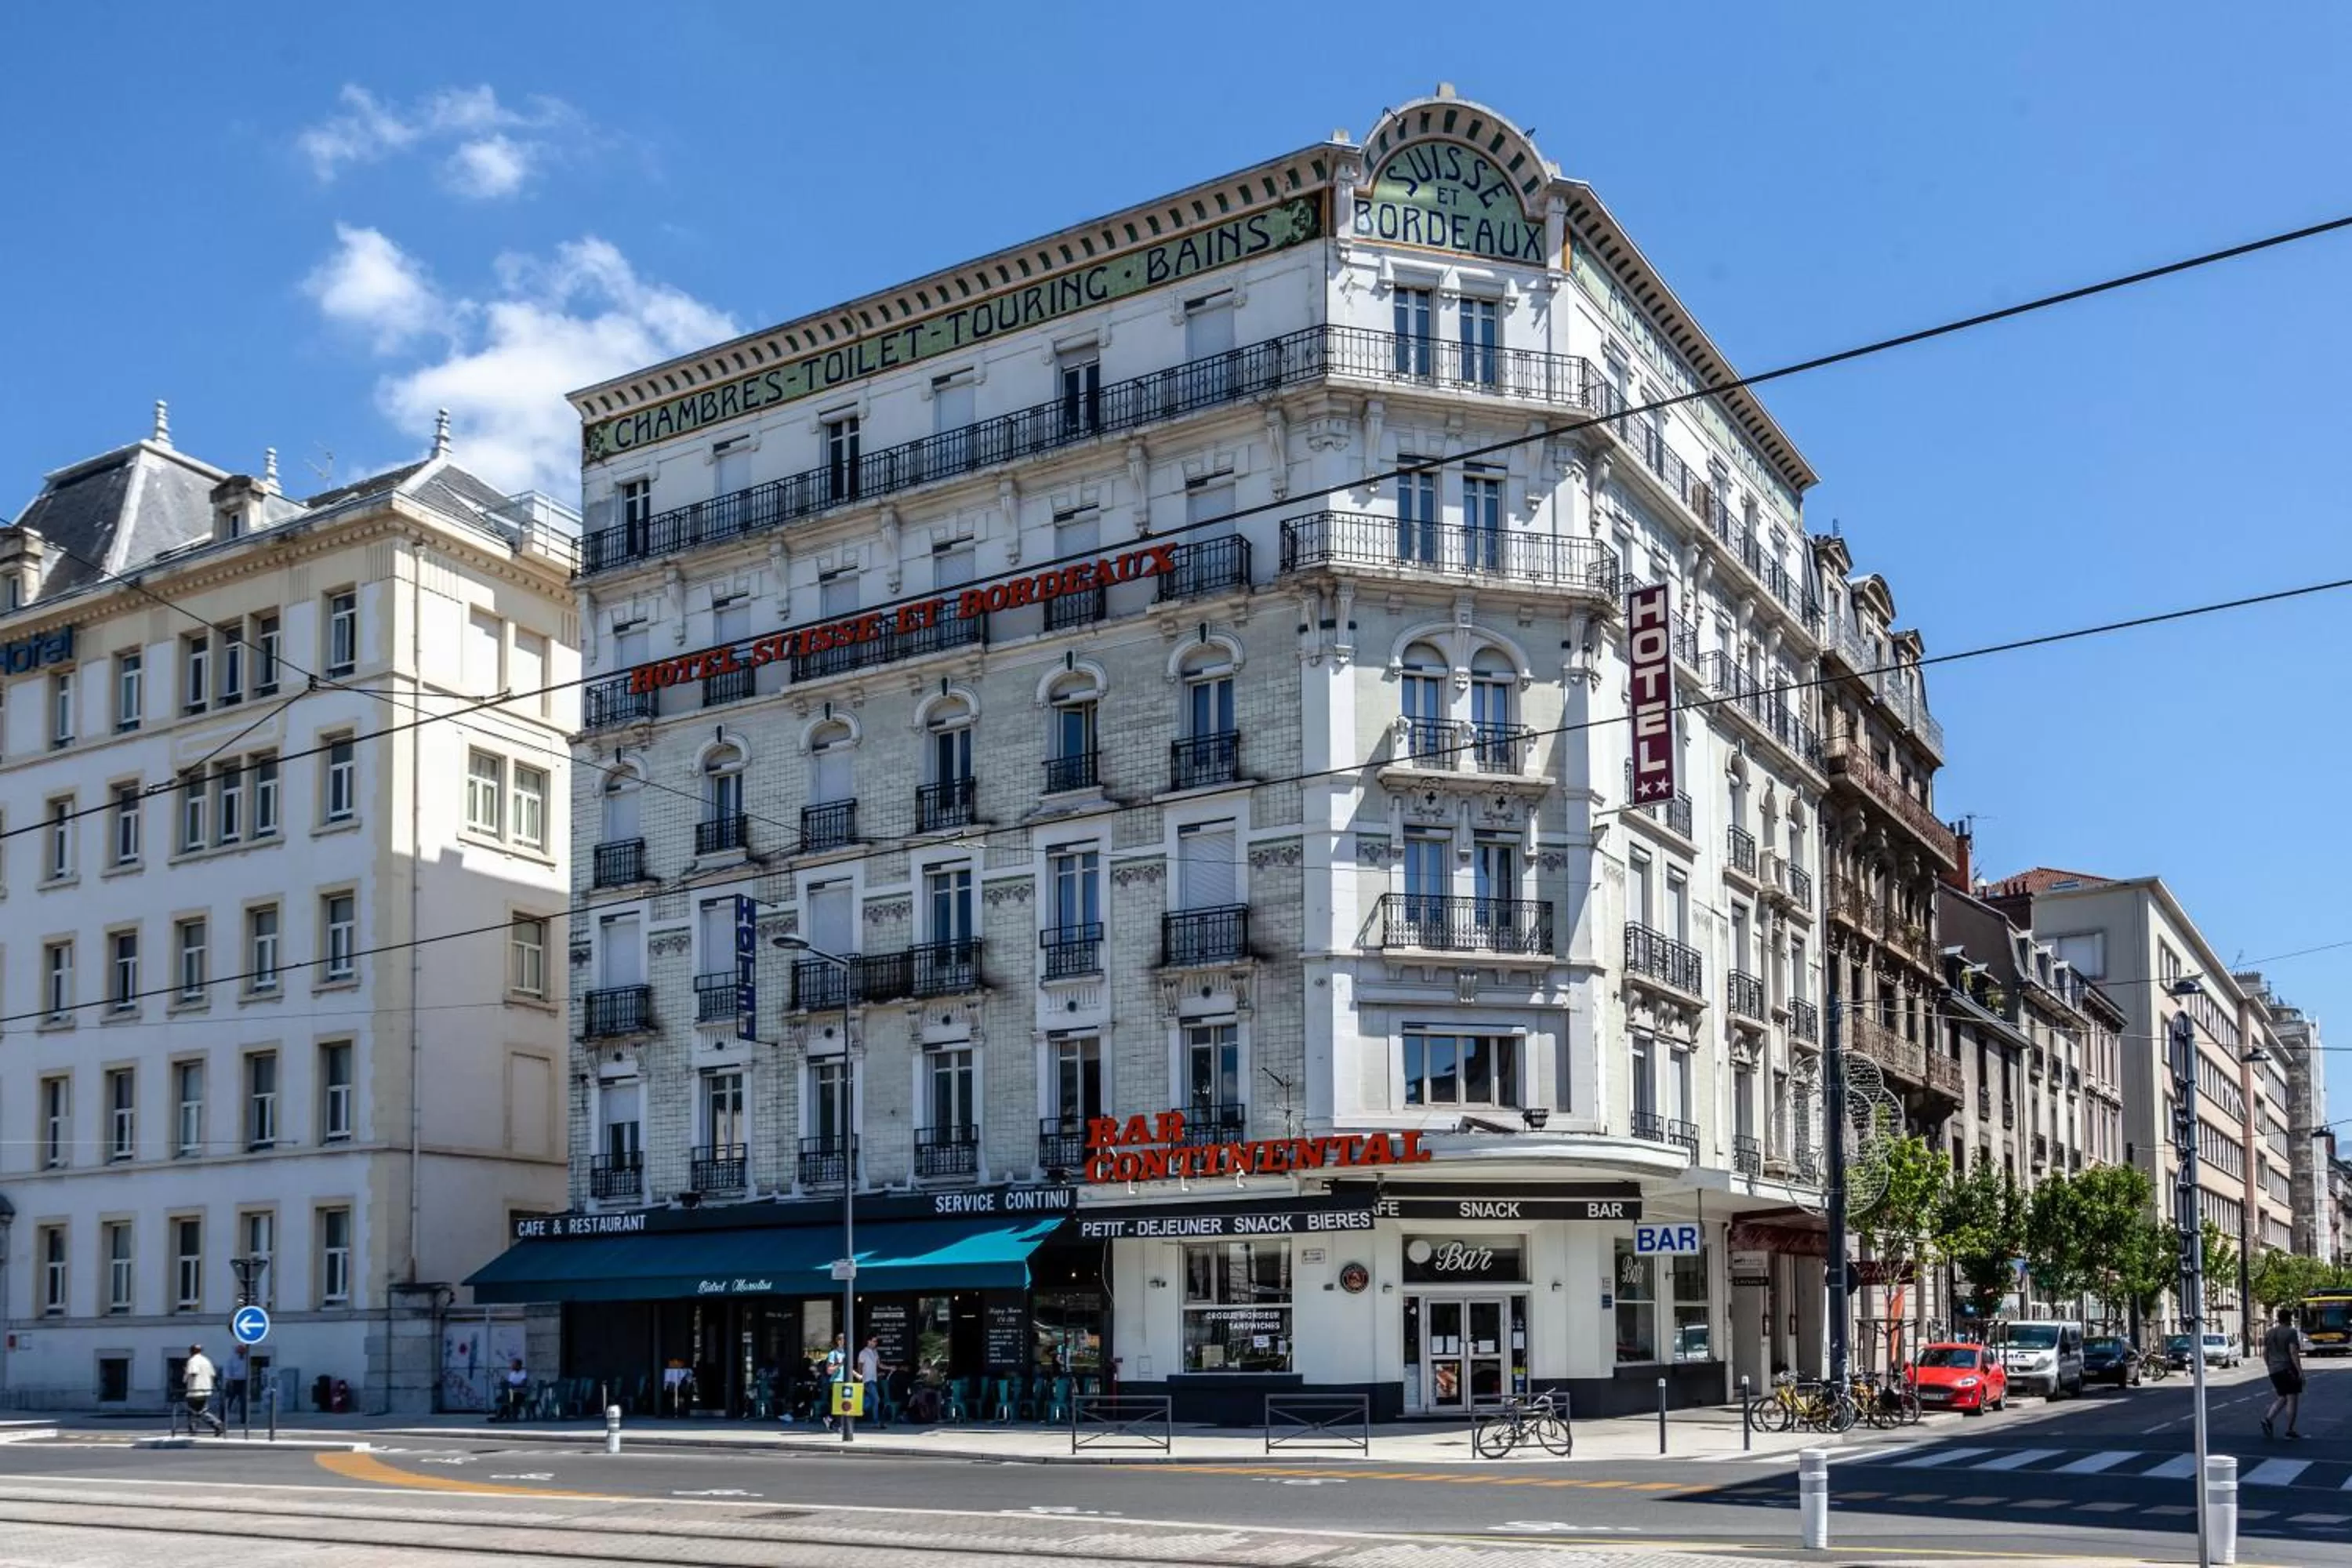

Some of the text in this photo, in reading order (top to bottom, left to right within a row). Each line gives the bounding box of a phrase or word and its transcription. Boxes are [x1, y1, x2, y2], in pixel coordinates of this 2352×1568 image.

[1385, 144, 1511, 209] SUISSE
[1437, 187, 1460, 206] ET
[1354, 199, 1542, 261] BORDEAUX
[615, 372, 782, 448] CHAMBRES
[800, 325, 925, 390] TOILET
[946, 265, 1109, 345] TOURING
[1147, 214, 1271, 284] BAINS
[630, 542, 1178, 695] HOTEL SUISSE ET BORDEAUX
[1632, 590, 1668, 774] HOTEL
[1085, 1111, 1185, 1148] BAR
[1085, 1129, 1432, 1185] CONTINENTAL
[935, 1189, 1069, 1213] SERVICE CONTINU
[1459, 1202, 1521, 1218] SNACK
[1588, 1203, 1624, 1218] BAR
[517, 1214, 647, 1236] CAFE & RESTAURANT
[1082, 1221, 1125, 1237] PETIT
[1138, 1218, 1222, 1236] DEJEUNER
[1234, 1216, 1293, 1233] SNACK
[1307, 1211, 1370, 1230] BIERES
[1638, 1227, 1696, 1252] BAR
[1435, 1241, 1494, 1271] Bar
[1229, 1322, 1280, 1331] SANDWICHES
